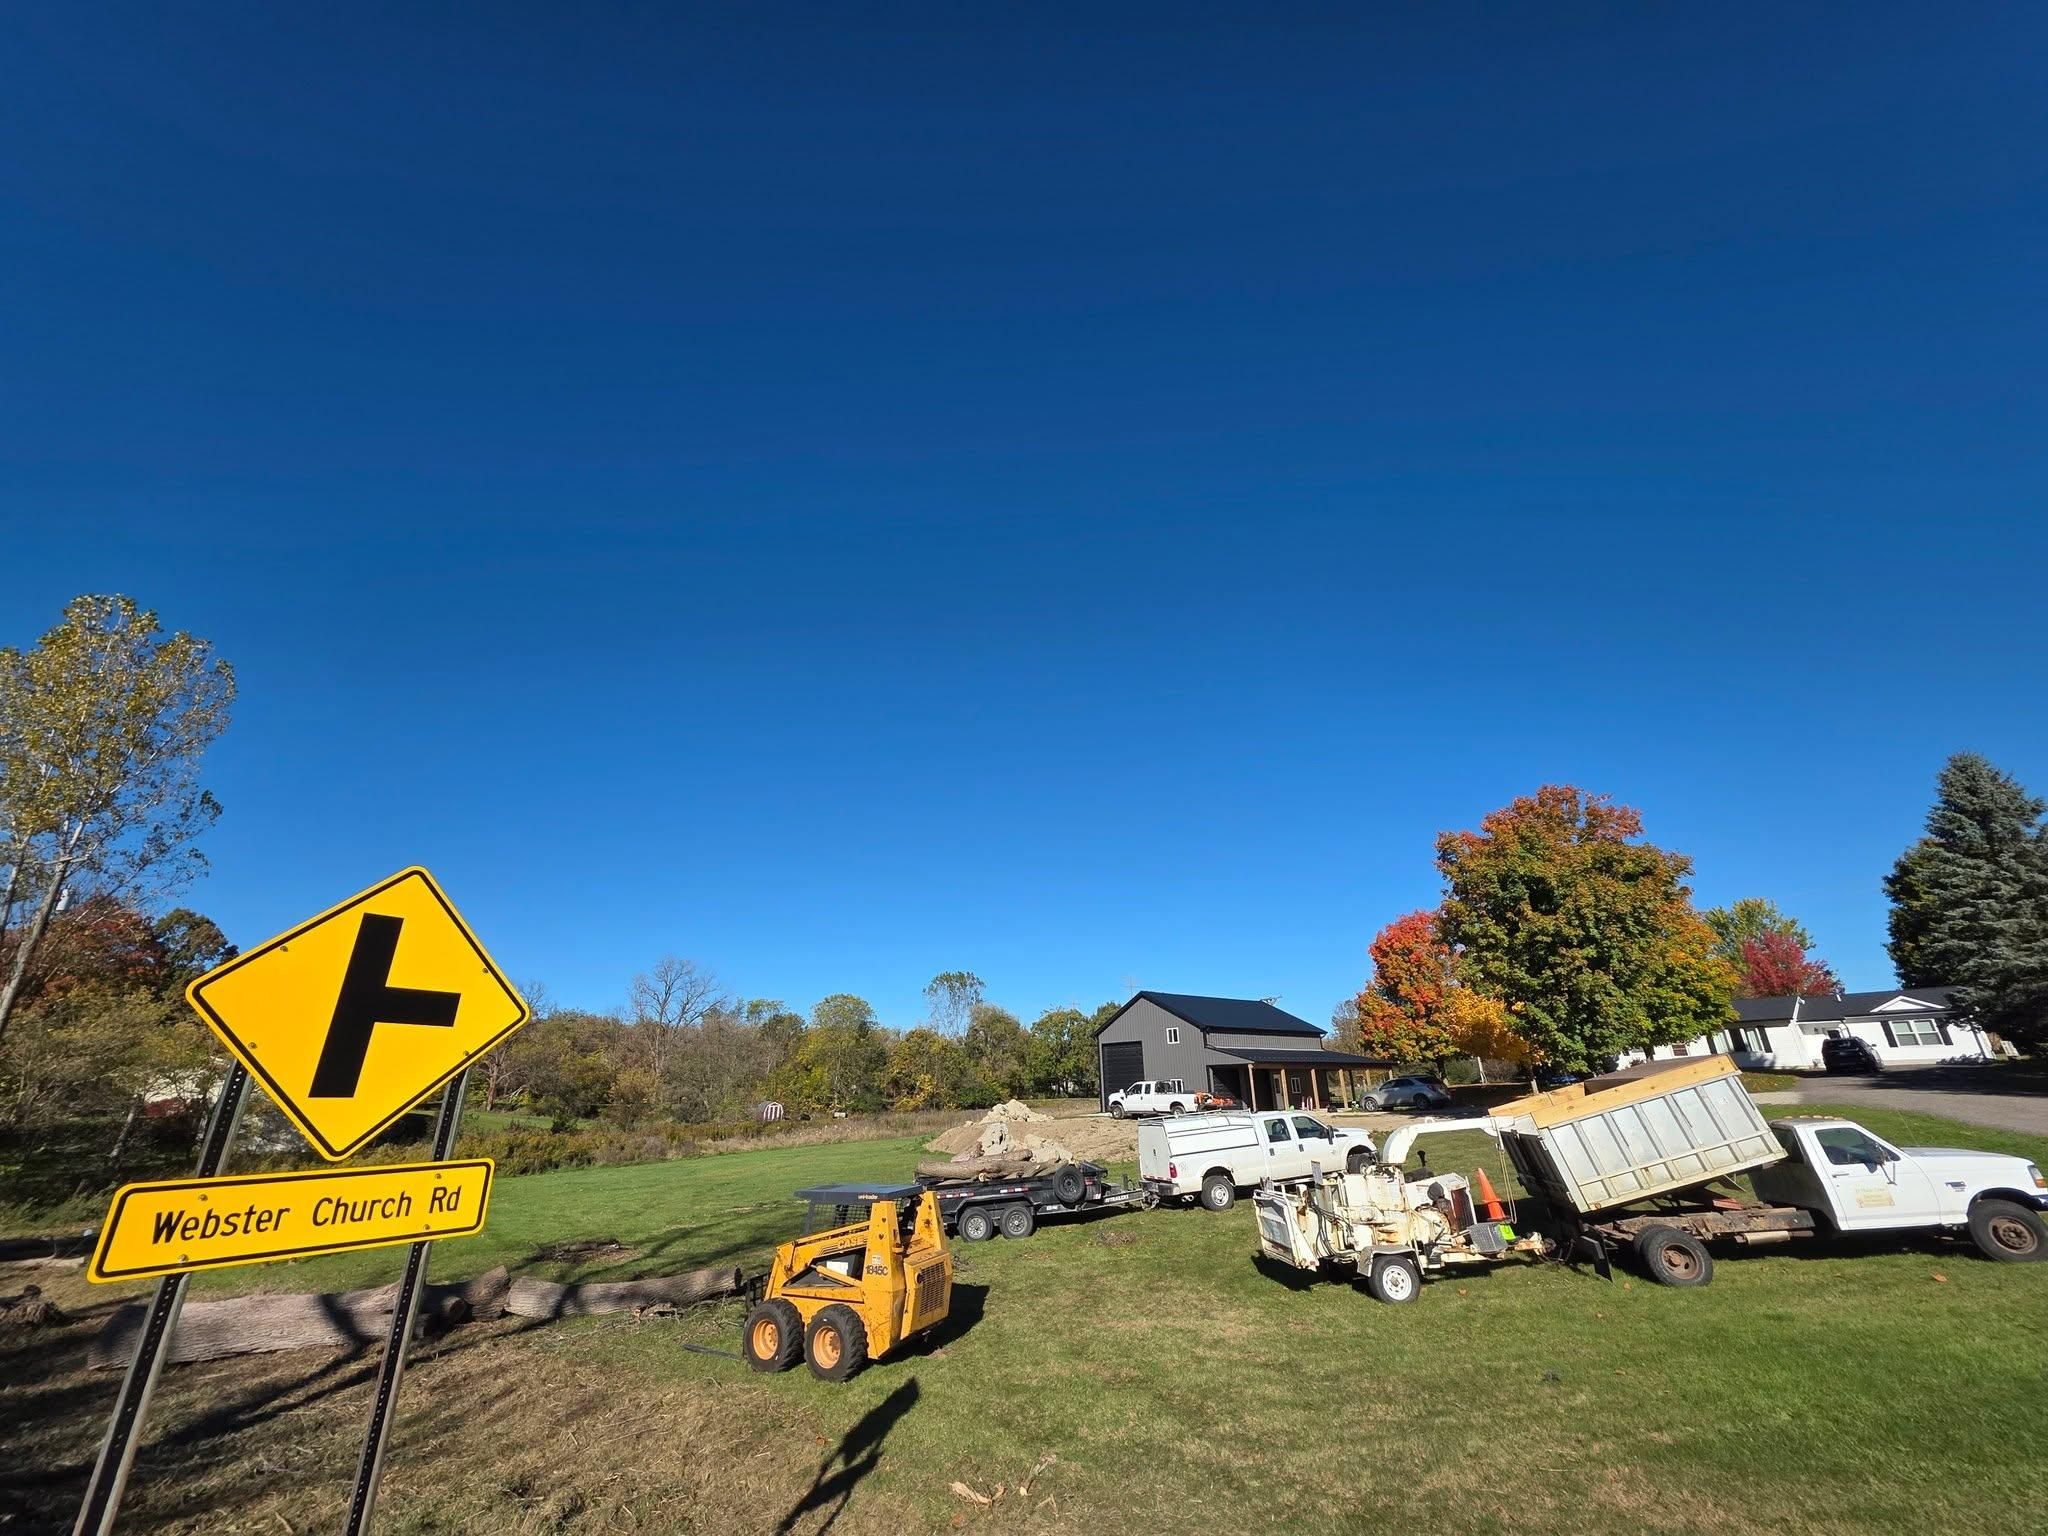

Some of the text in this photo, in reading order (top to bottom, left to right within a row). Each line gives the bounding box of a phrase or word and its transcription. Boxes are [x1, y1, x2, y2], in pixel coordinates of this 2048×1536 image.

[152, 1184, 462, 1245] Webster Church Rd
[838, 1236, 865, 1250] CASE
